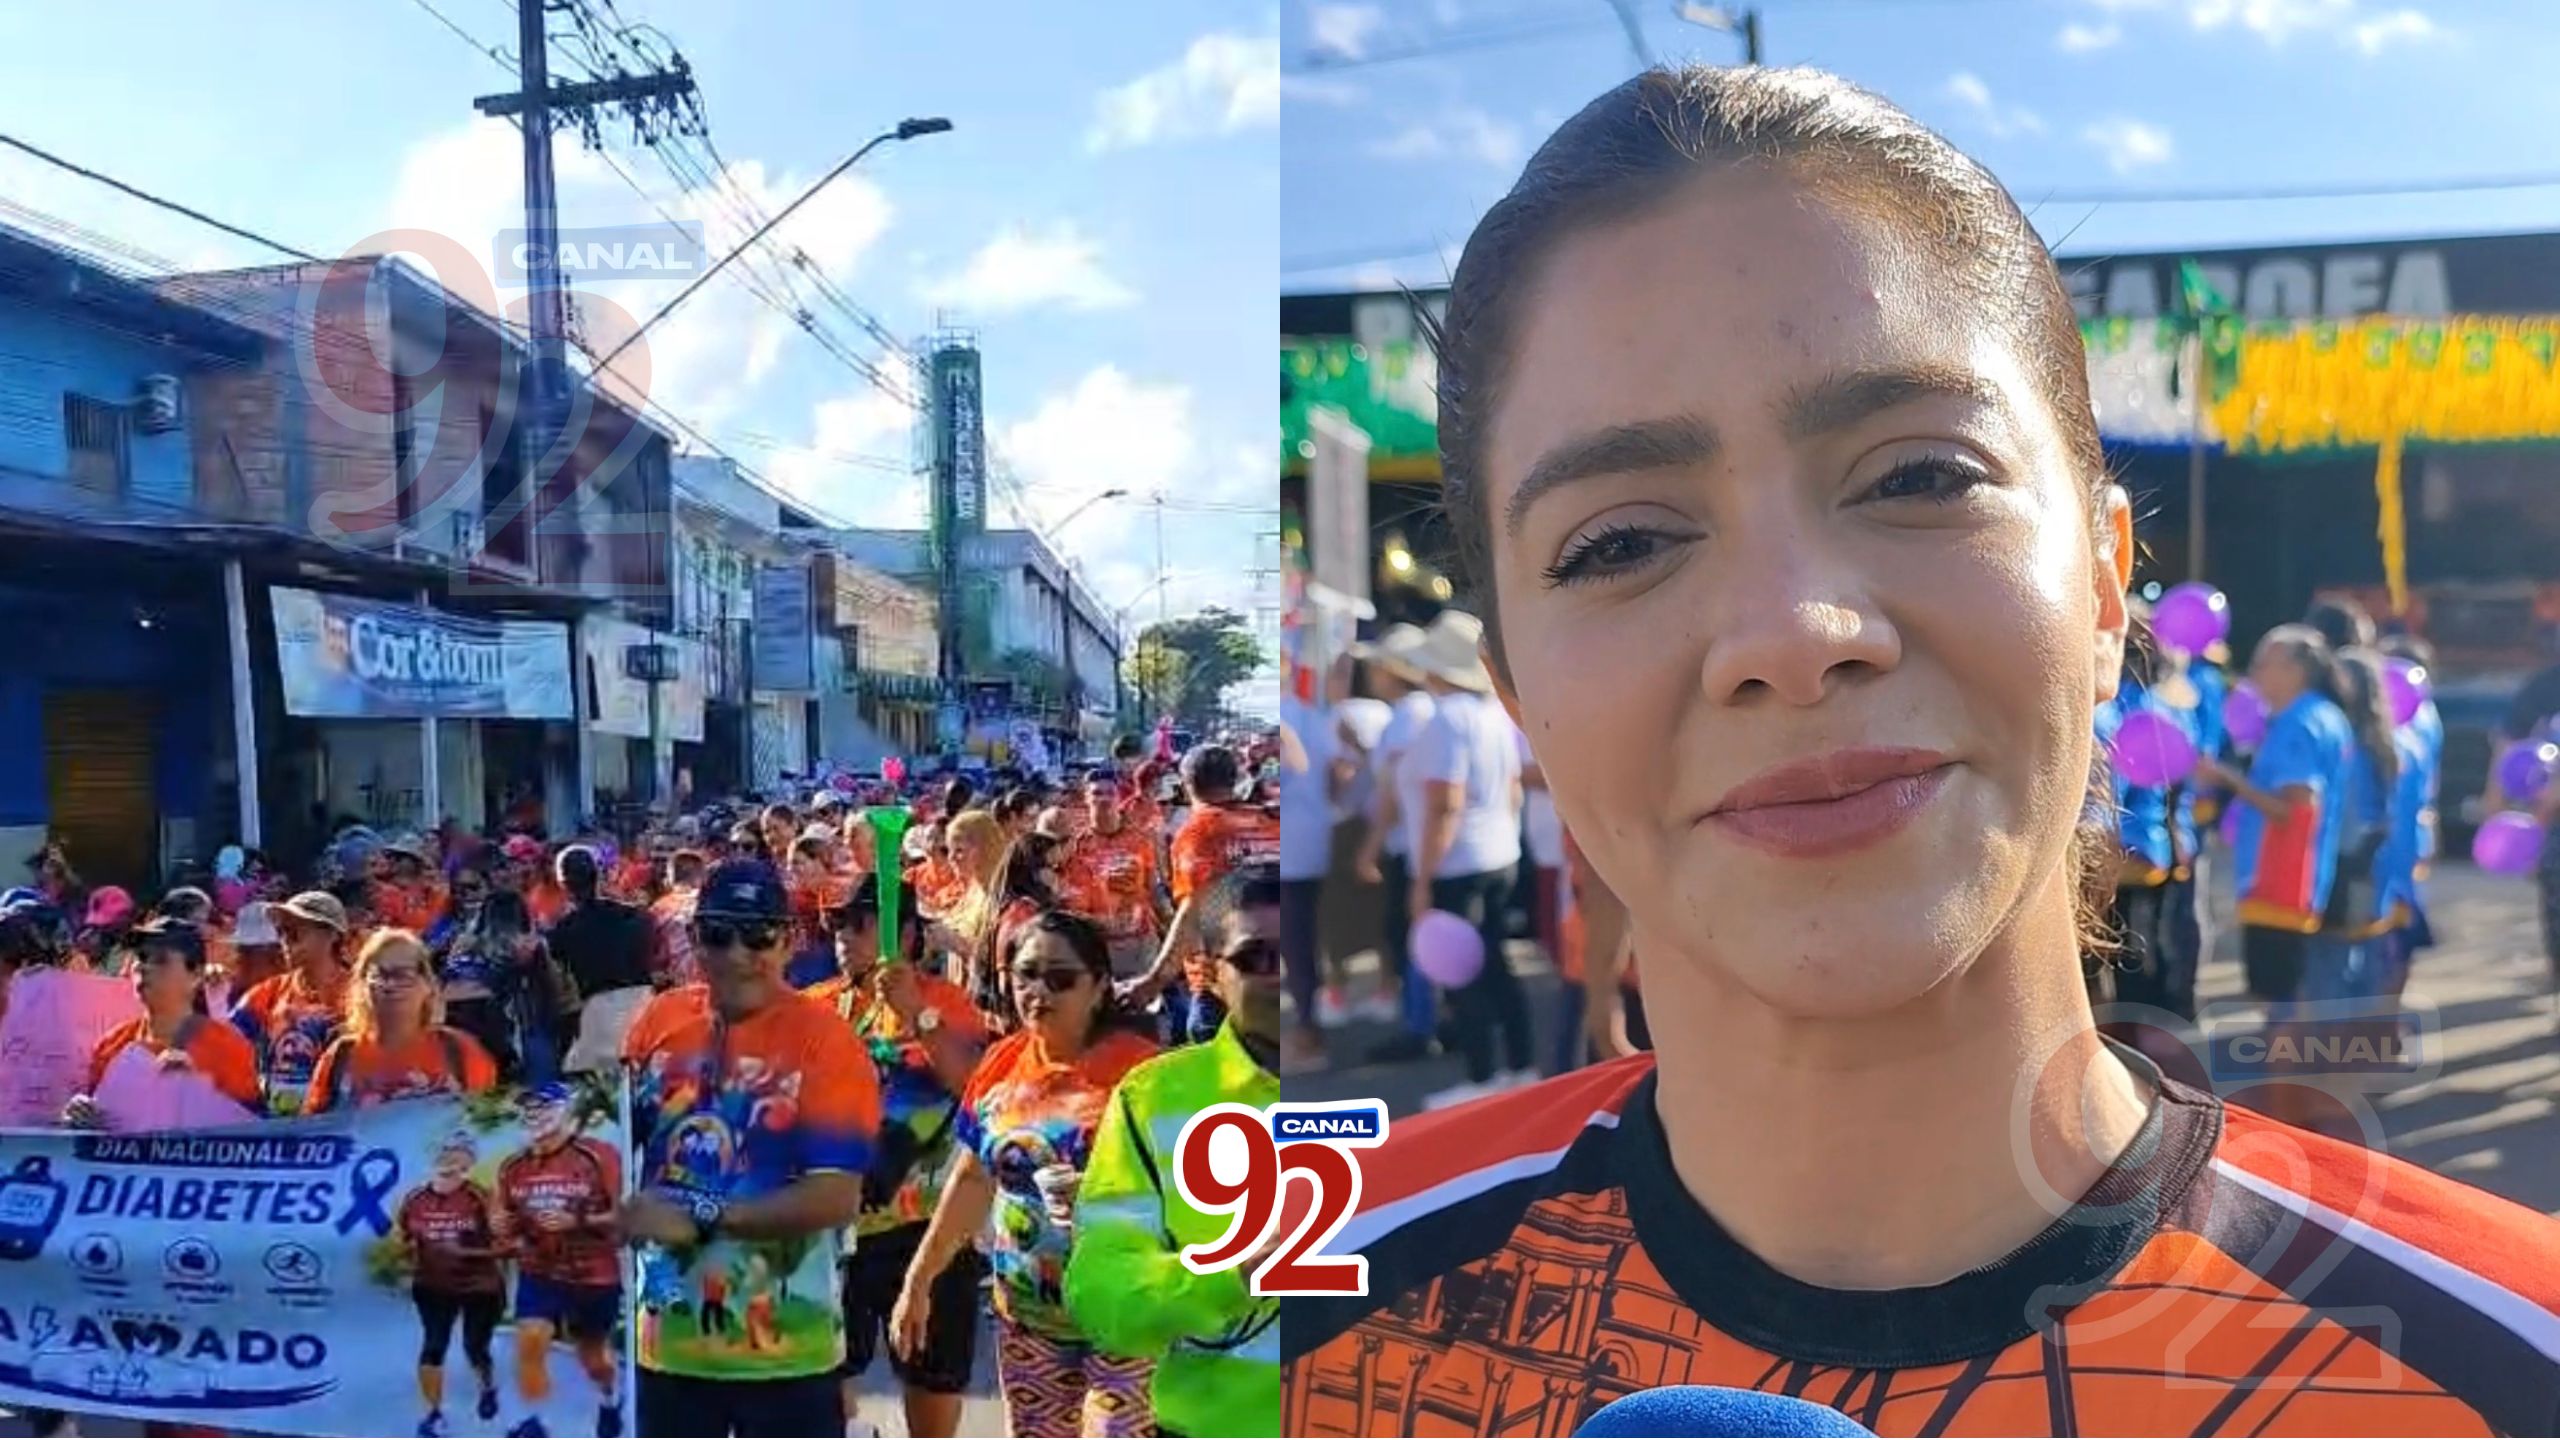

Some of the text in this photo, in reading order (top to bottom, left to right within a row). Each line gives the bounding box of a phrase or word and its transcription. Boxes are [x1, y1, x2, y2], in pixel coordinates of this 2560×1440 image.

[94, 1140, 335, 1164] DIA NACIONAL DO
[75, 1174, 335, 1225] DIABETES
